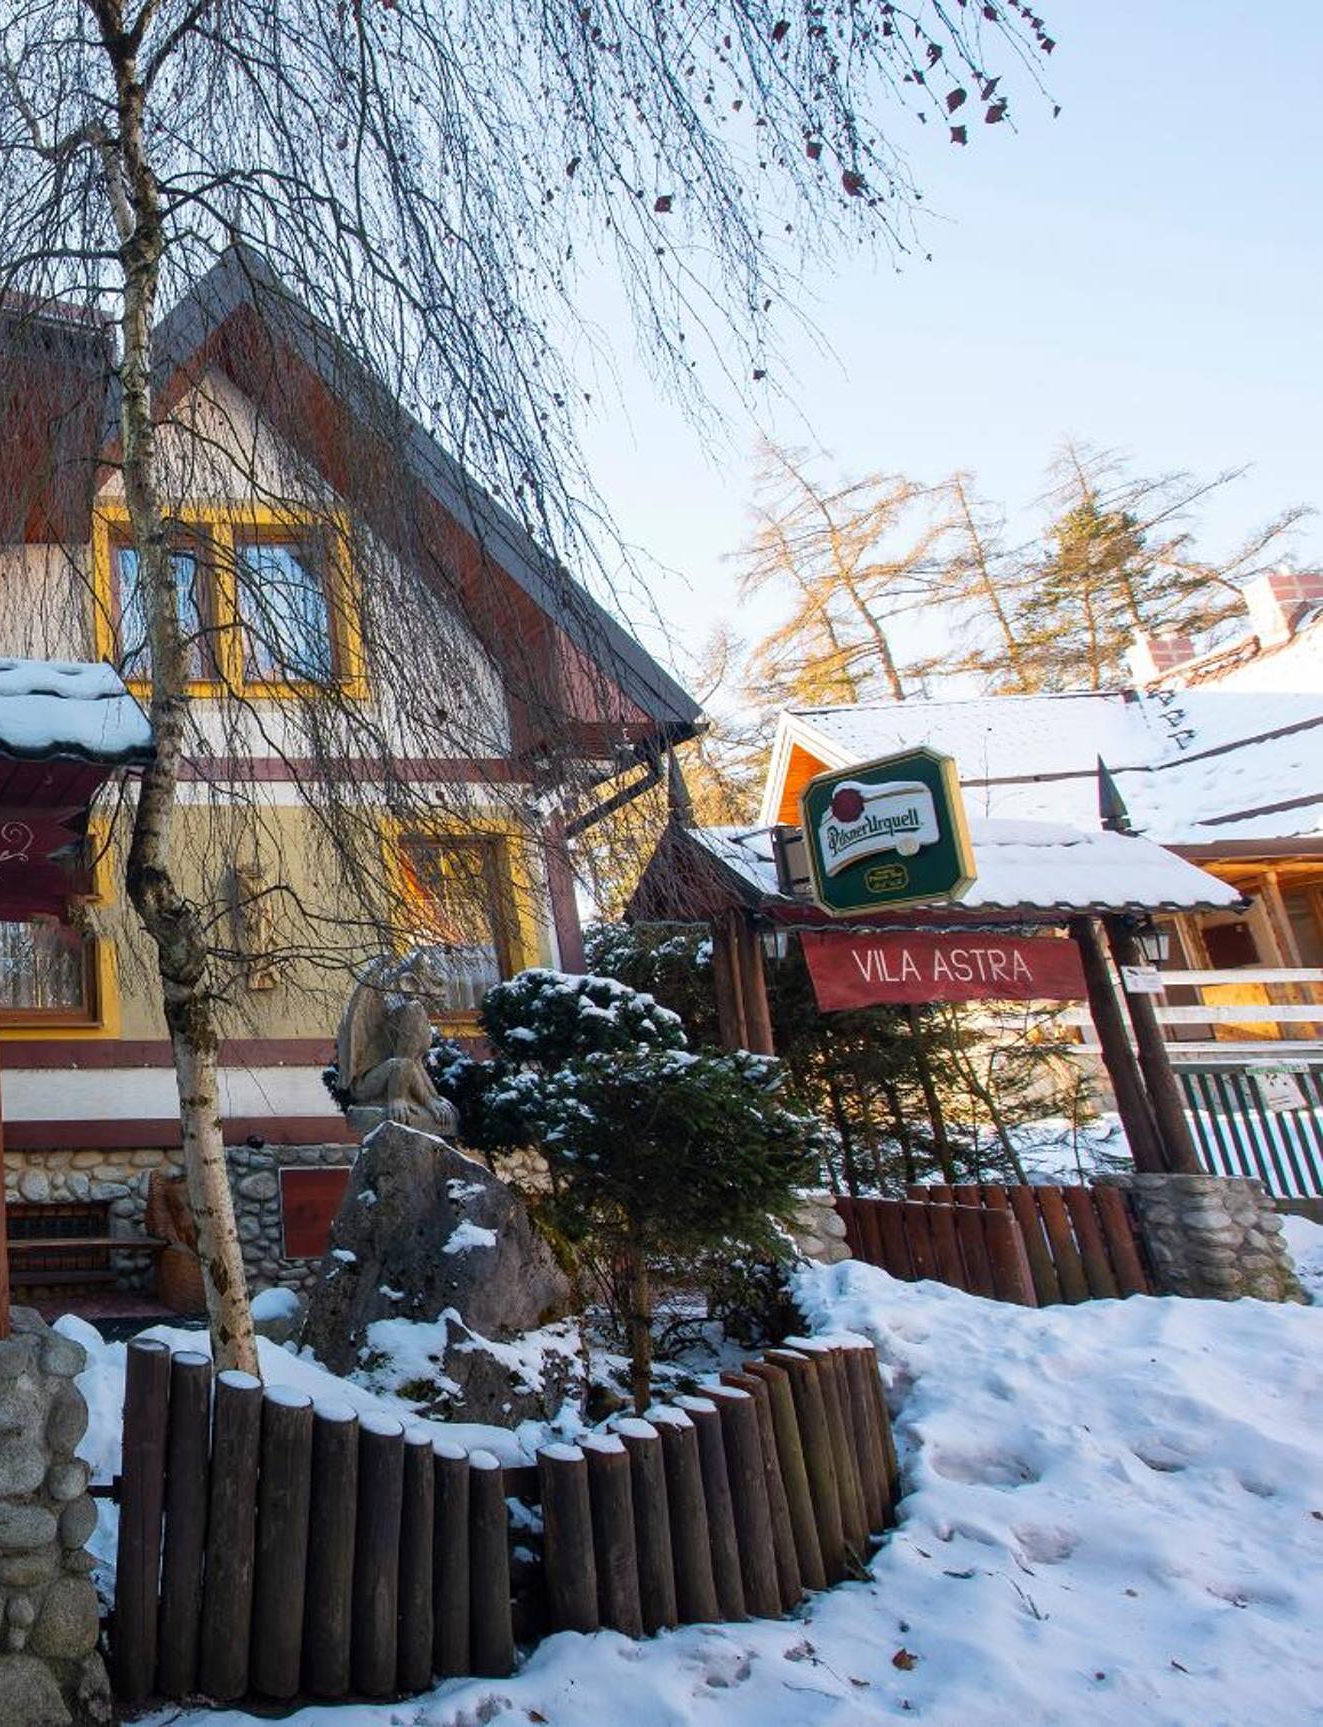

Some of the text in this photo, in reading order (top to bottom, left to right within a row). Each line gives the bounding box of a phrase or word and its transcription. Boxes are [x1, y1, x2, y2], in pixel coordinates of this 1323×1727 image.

[827, 808, 919, 857] Pilsner Urquell
[852, 949, 1034, 982] VILA ASTRA
